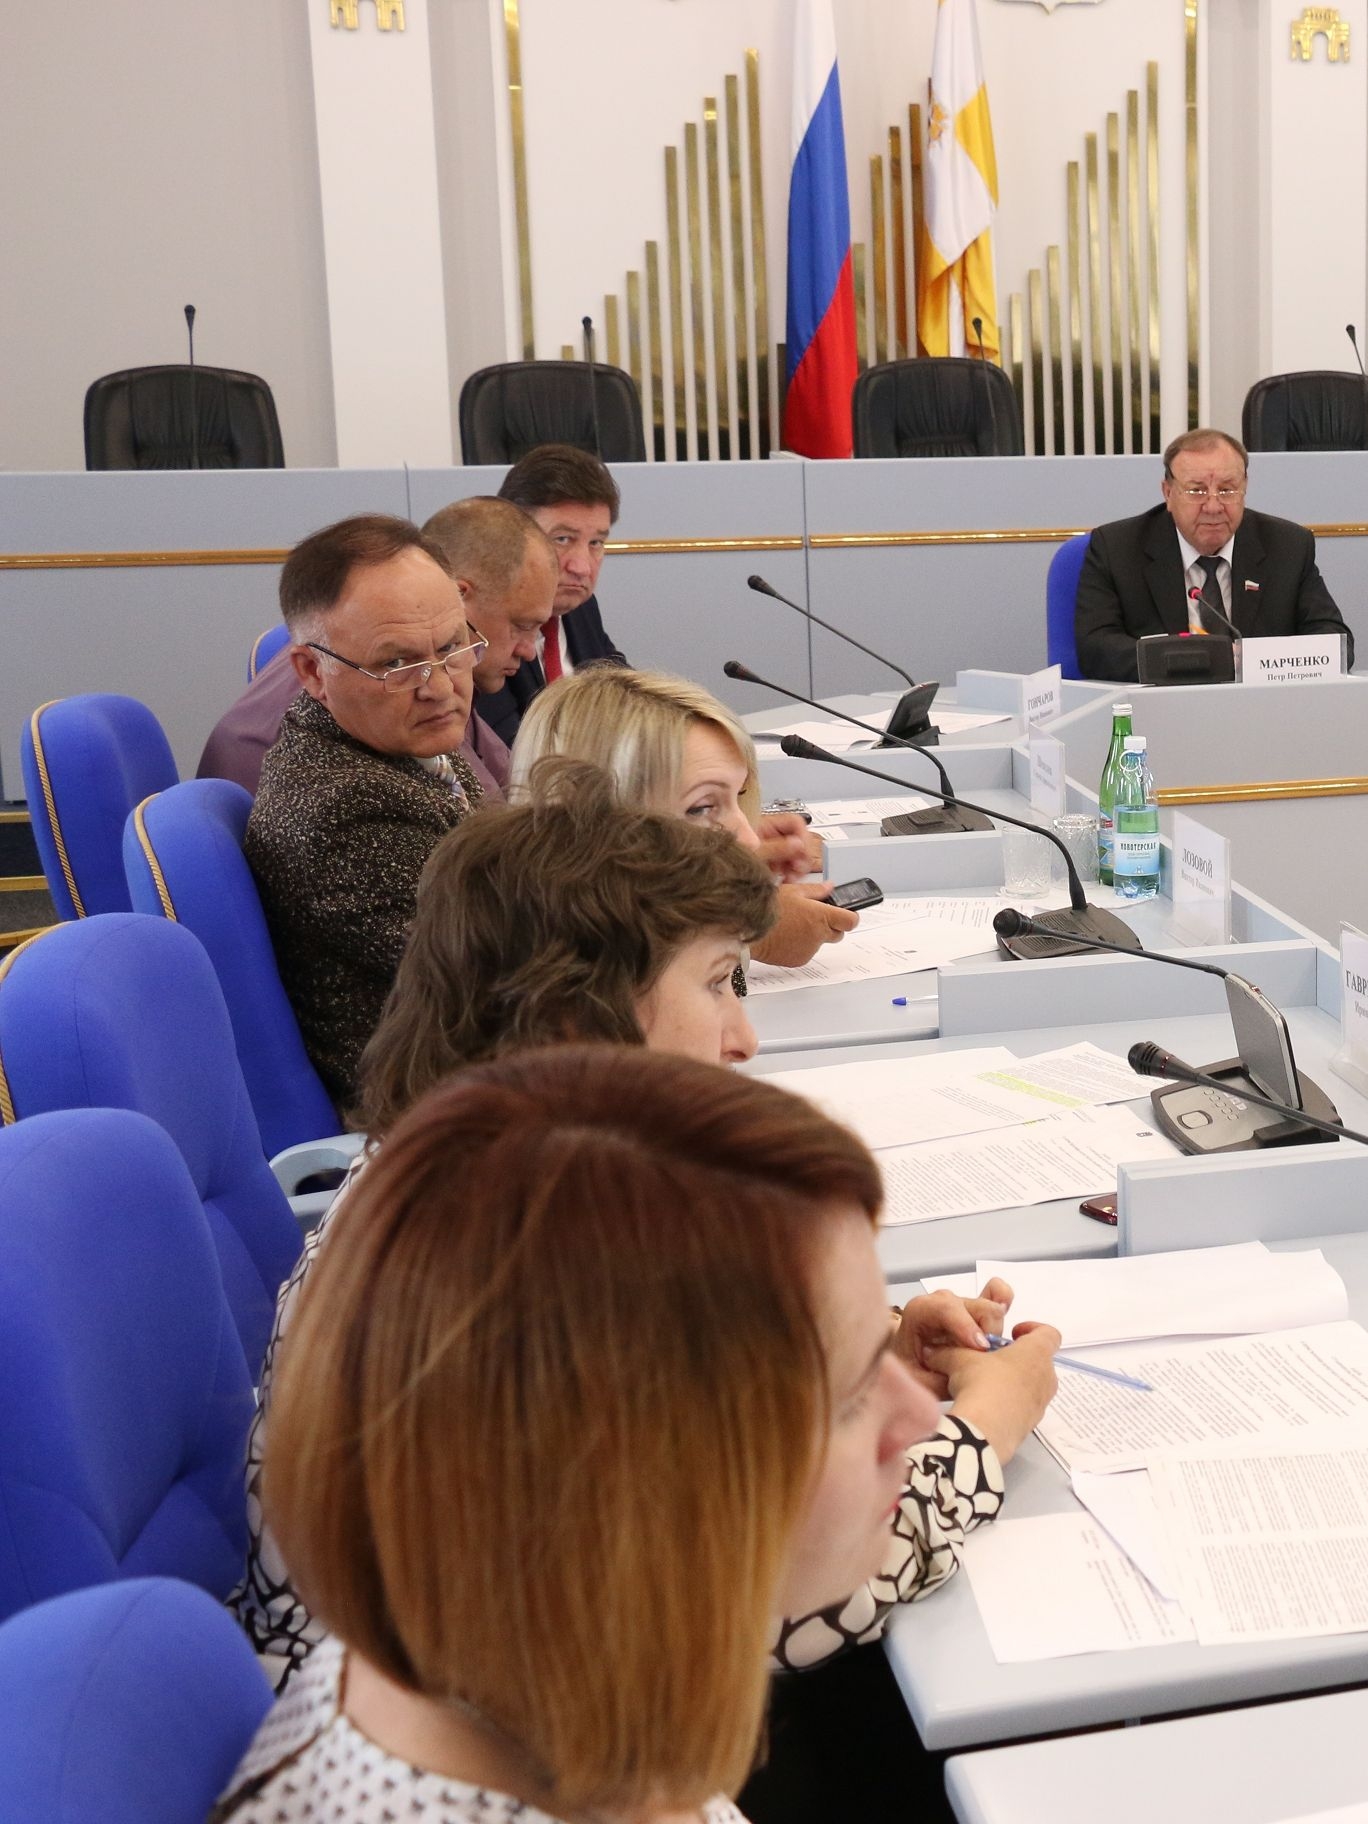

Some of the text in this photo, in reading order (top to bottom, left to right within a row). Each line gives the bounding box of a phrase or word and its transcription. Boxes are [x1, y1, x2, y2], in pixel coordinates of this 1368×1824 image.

[1259, 655, 1330, 669] МАРЧЕНКО
[1267, 671, 1323, 682] Петр Петрович
[1182, 848, 1213, 879] ЛОЗОВОЙ
